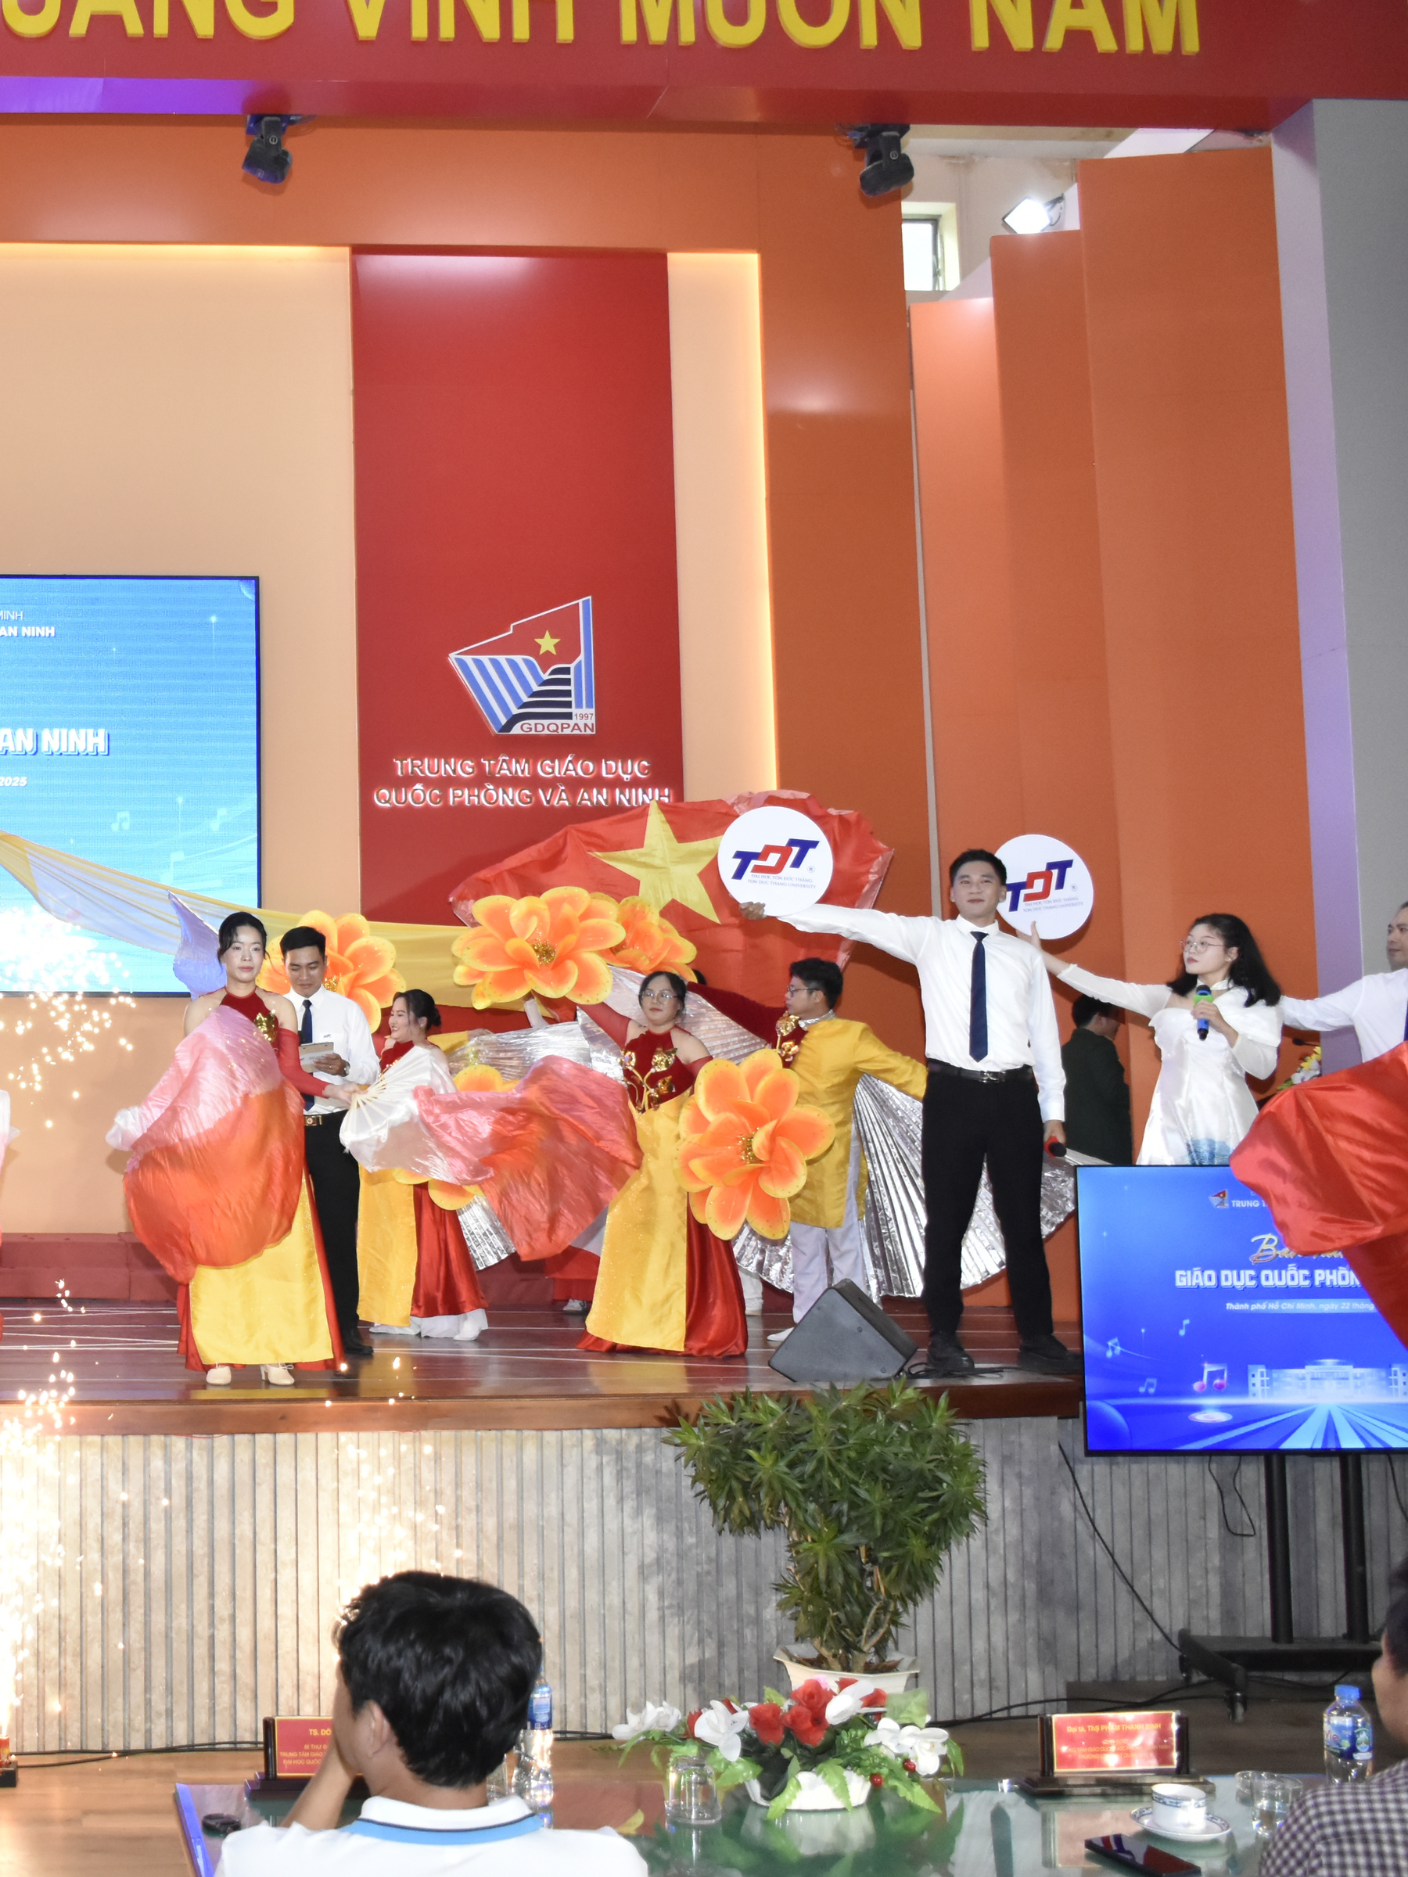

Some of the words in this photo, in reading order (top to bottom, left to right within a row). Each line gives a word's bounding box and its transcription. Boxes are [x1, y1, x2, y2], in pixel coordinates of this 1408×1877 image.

[22, 626, 55, 637] NINH
[520, 722, 594, 733] GDQPAN
[41, 728, 108, 755] NINH
[393, 758, 476, 777] TRUNG
[481, 753, 530, 777] TÂM
[537, 754, 595, 778] GIÁO
[602, 758, 652, 782] DỤC
[374, 782, 442, 807] QUỐC
[449, 782, 533, 807] PHÒNG
[538, 783, 571, 806] VÀ
[576, 788, 609, 806] AN
[615, 788, 671, 806] NINH
[1176, 1268, 1217, 1288] GIÁO
[1220, 1270, 1257, 1290] DỤC
[1260, 1264, 1311, 1288] QUỐC
[1226, 1302, 1249, 1310] Thành
[1281, 1302, 1294, 1310] Chí
